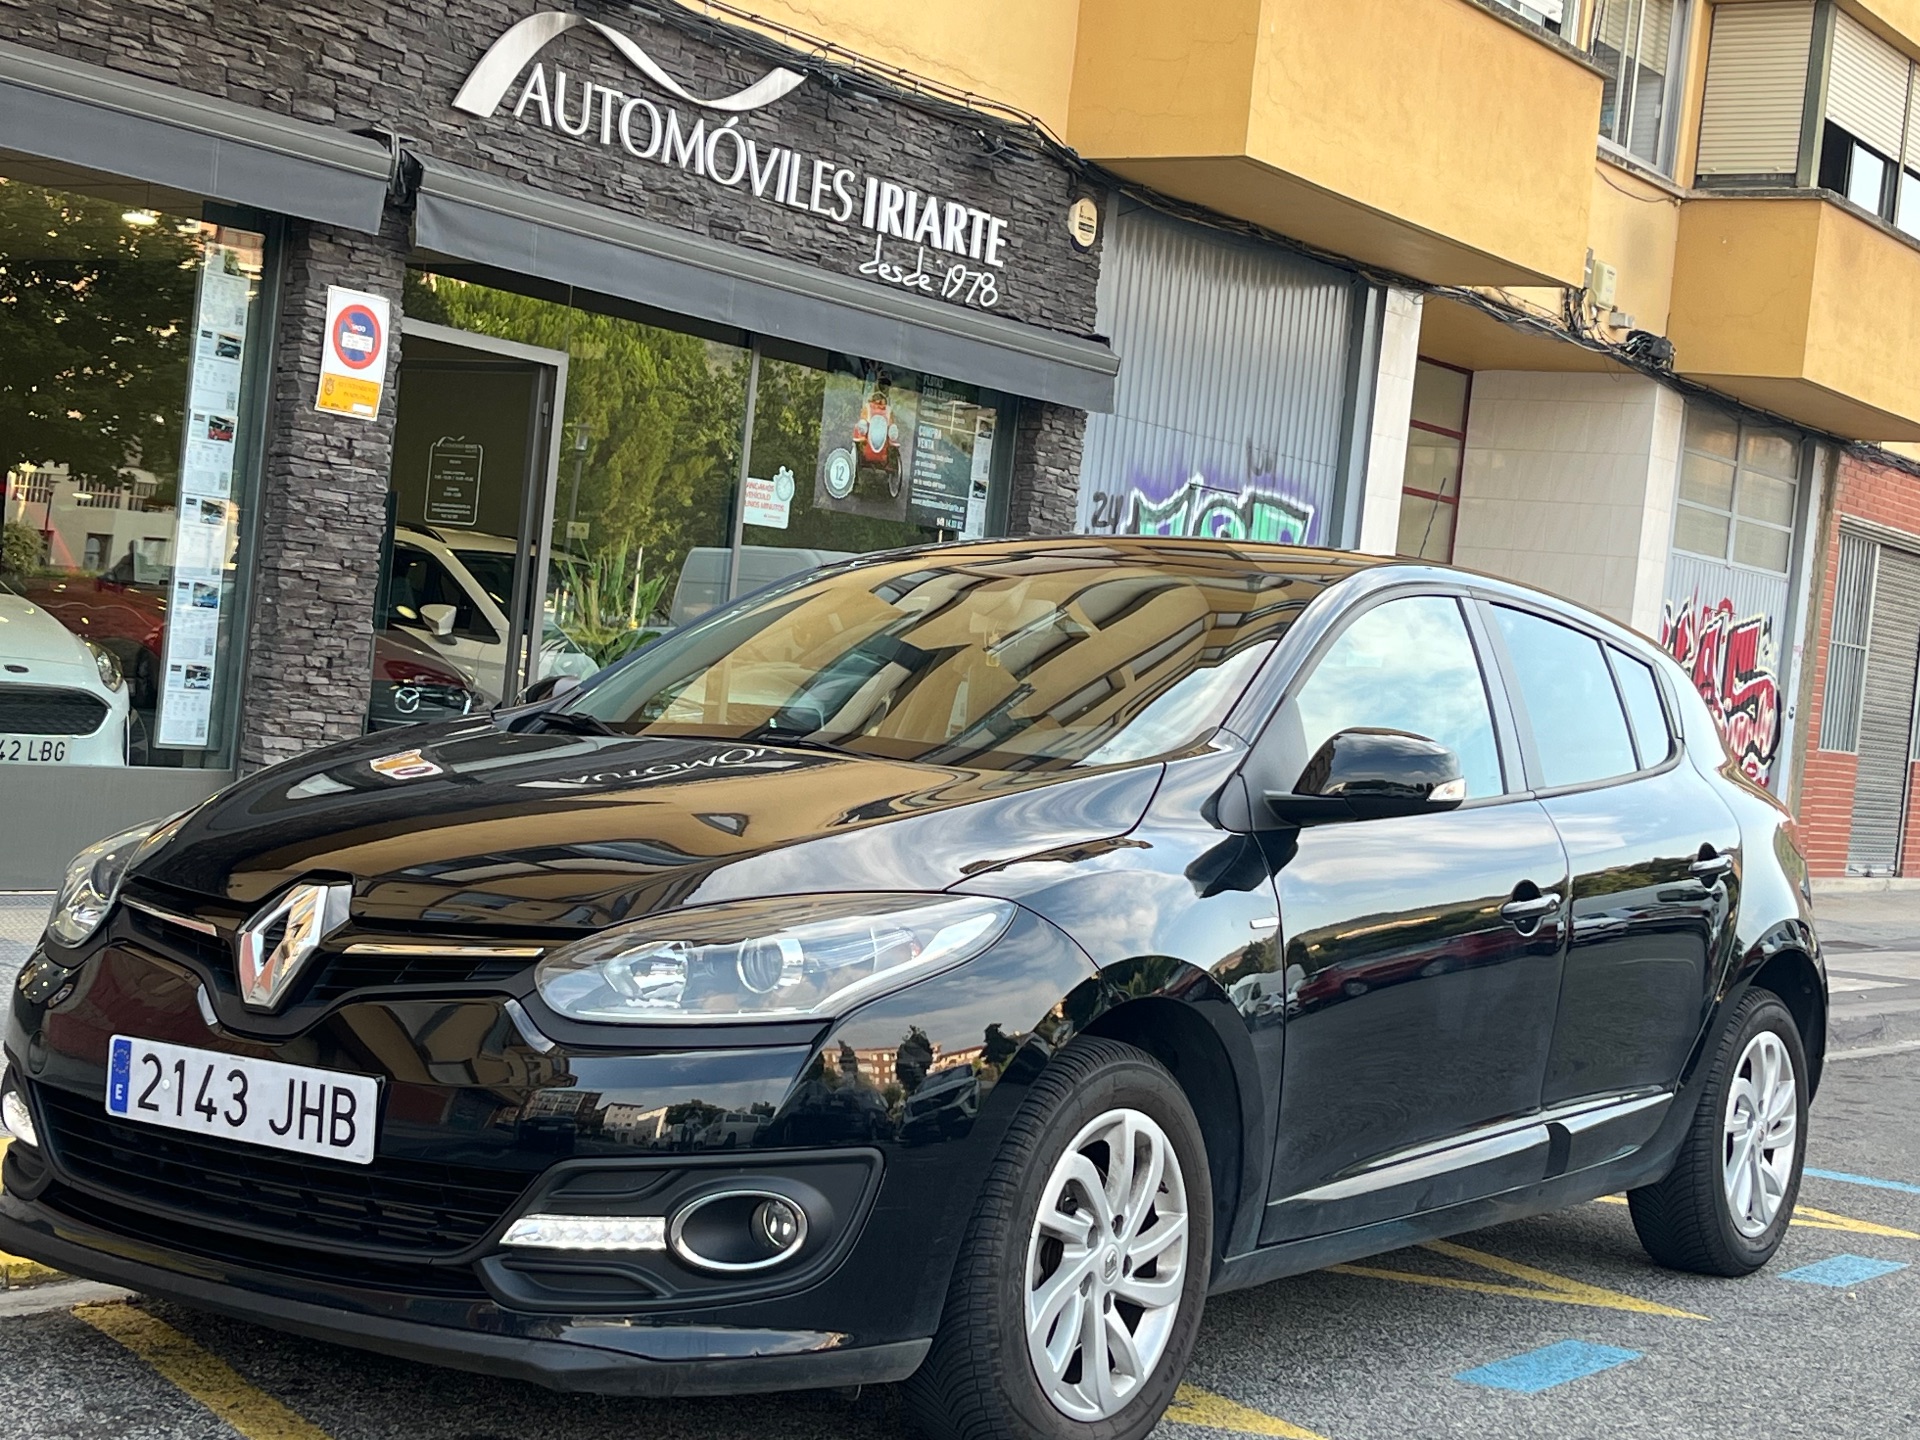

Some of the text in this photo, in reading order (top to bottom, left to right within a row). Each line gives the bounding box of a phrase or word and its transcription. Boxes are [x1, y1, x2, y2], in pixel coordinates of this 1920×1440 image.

[513, 62, 1008, 267] AUTOMÓVILES IRIARTE
[858, 233, 999, 308] desde 1978
[27, 740, 65, 761] LBG
[114, 1052, 357, 1148] E 2143 JHB
